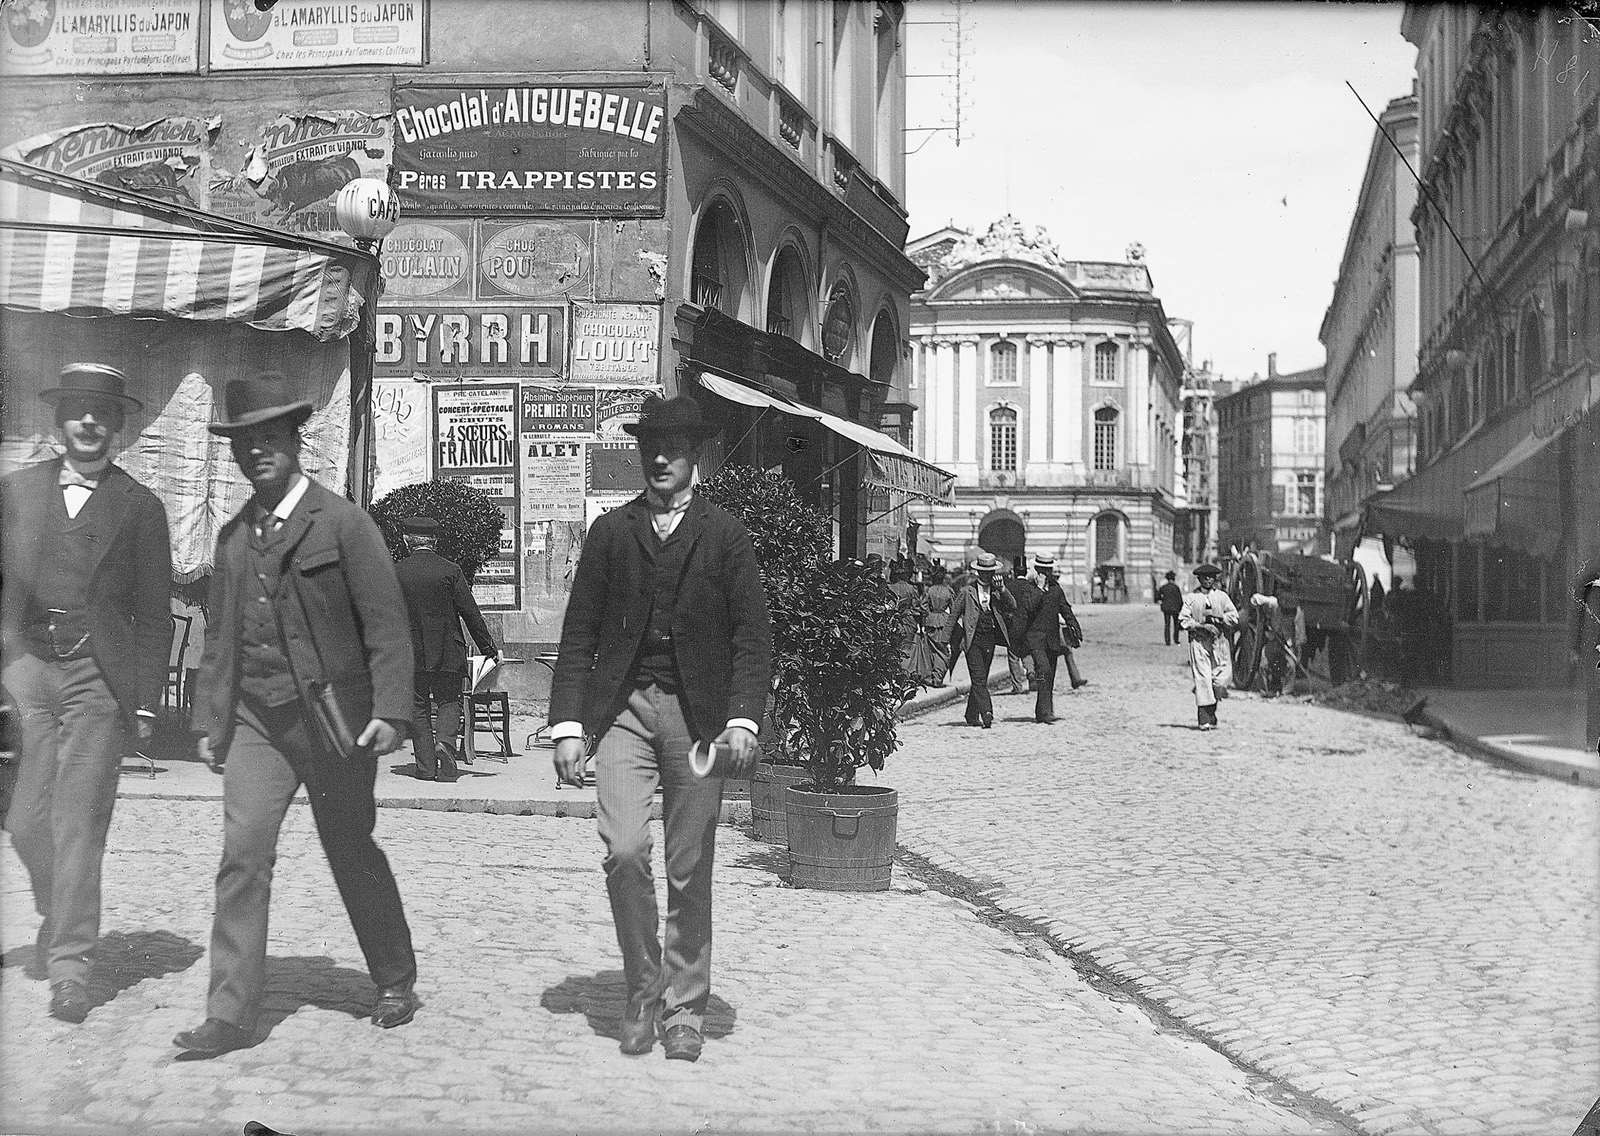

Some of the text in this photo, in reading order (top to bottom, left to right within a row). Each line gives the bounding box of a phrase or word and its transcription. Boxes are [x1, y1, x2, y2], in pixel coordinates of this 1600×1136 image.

[62, 13, 136, 33] L'AMARYLLIS
[152, 12, 190, 31] JAPON
[282, 4, 358, 26] L'AMARYLLIS
[360, 10, 372, 23] du
[374, 3, 414, 22] JAPON
[396, 89, 488, 143] Chocolat
[114, 151, 145, 167] EXTRAIT
[153, 147, 183, 159] VIANDE
[269, 154, 295, 169] MEILLEUR
[296, 145, 328, 161] EXTRAIT
[337, 139, 367, 152] VIANDE
[456, 171, 657, 189] TRAPPISTES
[387, 238, 444, 252] CHOCOLAT
[383, 256, 462, 278] OULAIN
[376, 313, 549, 365] BYRRH
[583, 323, 649, 339] CHOCOLAT
[576, 338, 654, 363] LOUIT
[523, 391, 553, 403] Absinthe
[439, 405, 513, 414] CONCERT-SPECTACLE
[524, 403, 592, 417] PREMIER FILS
[597, 404, 625, 421] HUILES
[446, 426, 456, 441] 4
[439, 440, 513, 467] FRANKLIN
[528, 444, 580, 457] ALET
[501, 540, 513, 549] EZ
